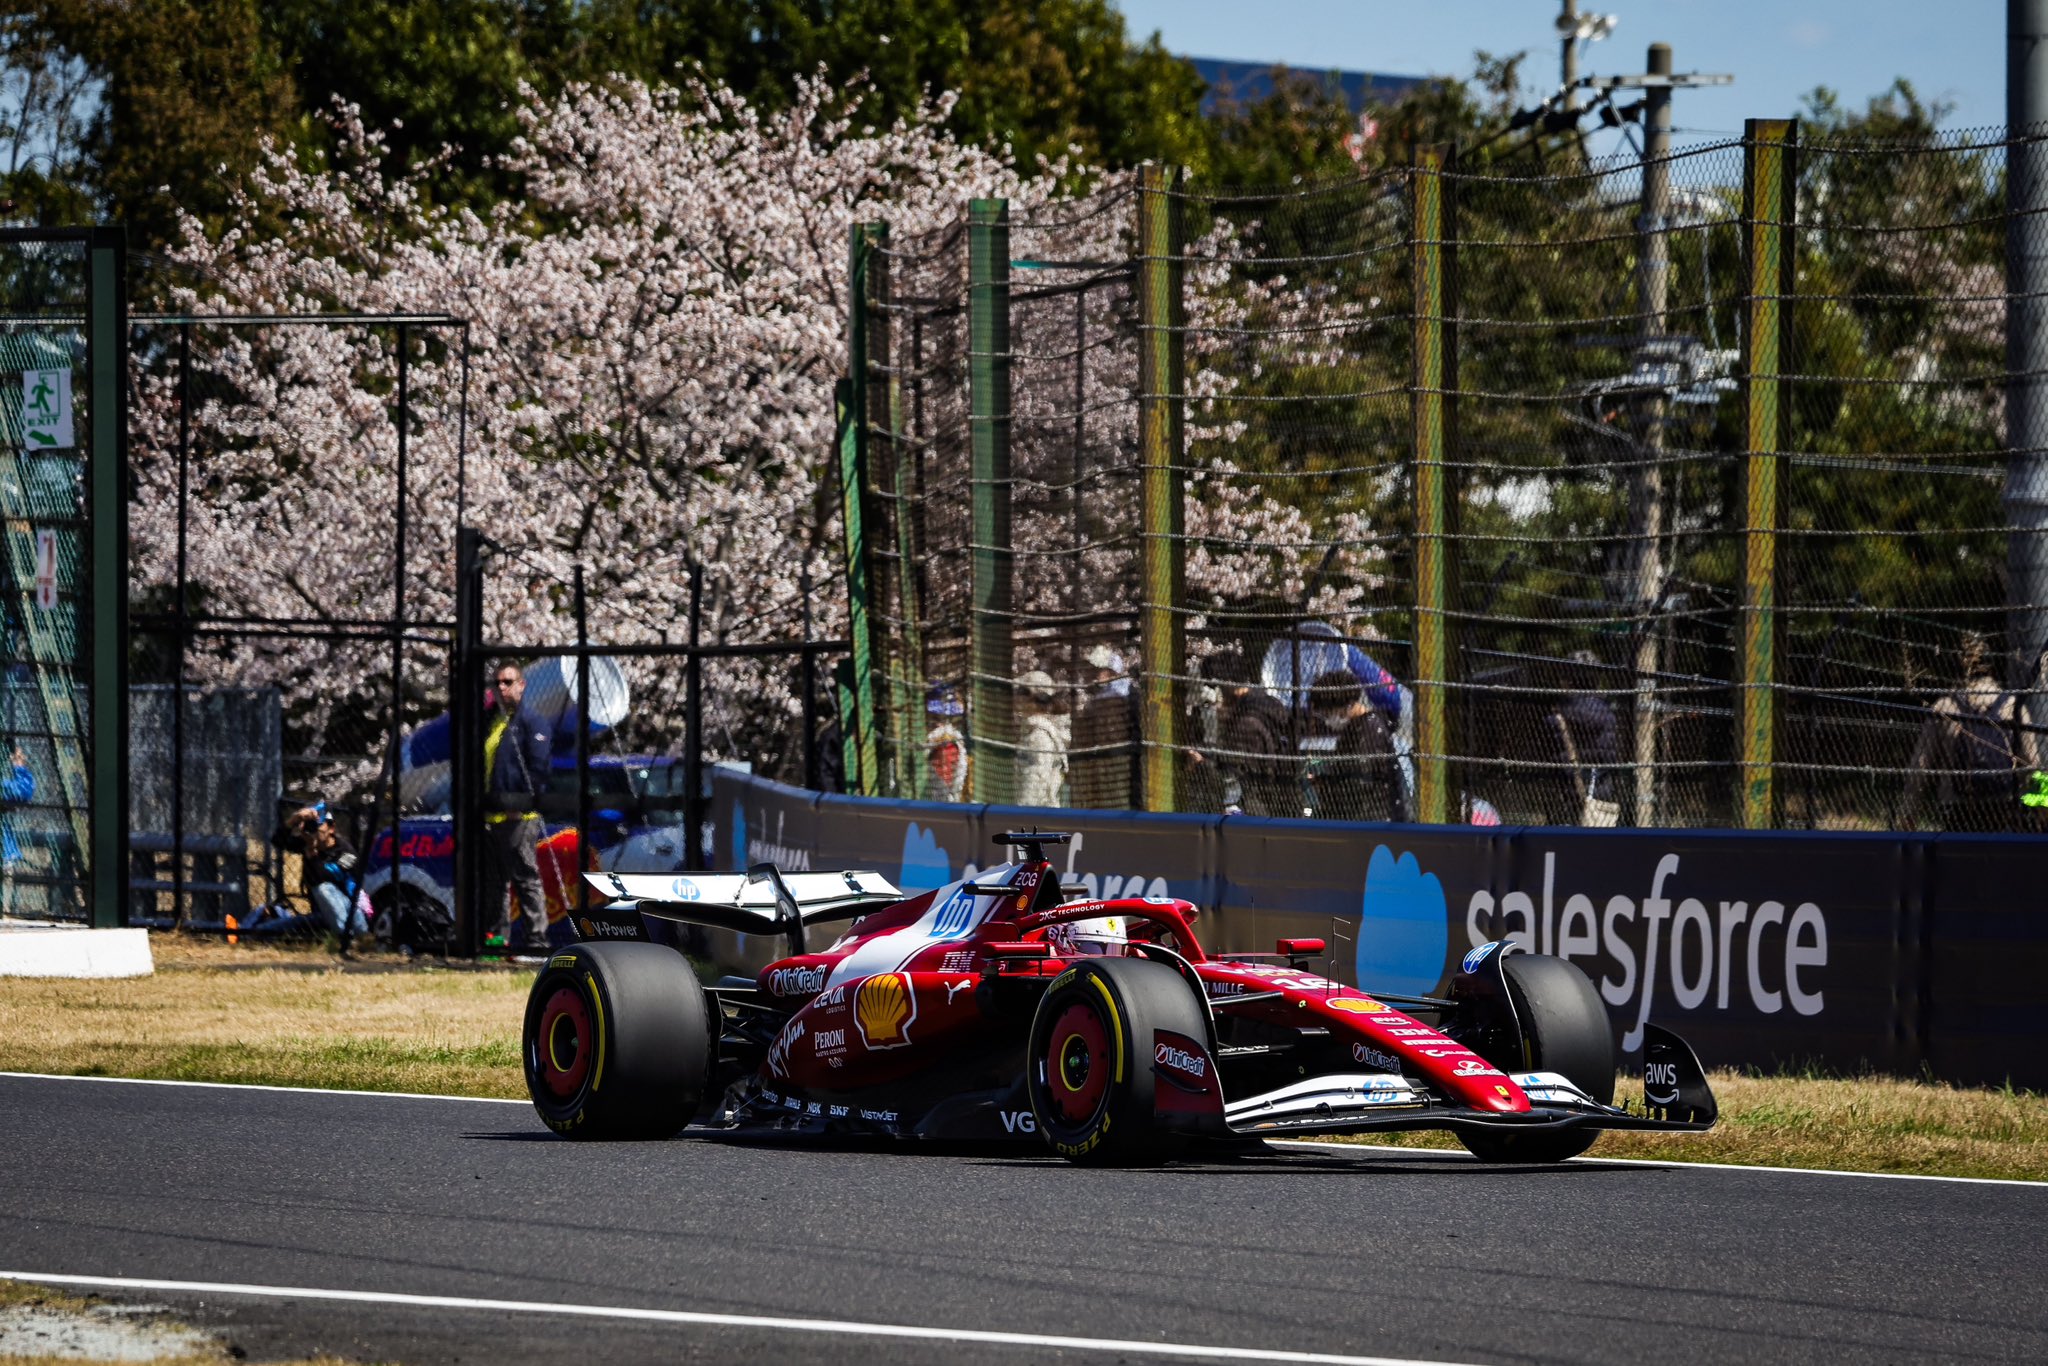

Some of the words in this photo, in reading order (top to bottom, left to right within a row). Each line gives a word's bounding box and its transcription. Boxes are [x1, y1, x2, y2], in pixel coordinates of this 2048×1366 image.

[28, 418, 60, 427] EXIT
[675, 880, 699, 900] hp
[1015, 872, 1038, 887] ZCG
[931, 884, 974, 938] hp
[1058, 904, 1105, 916] TECHNOLOGY
[592, 921, 637, 936] V-Power
[937, 951, 976, 974] IBM
[1466, 852, 1828, 1053] salesforce
[780, 964, 828, 995] UniCredit
[1211, 982, 1245, 994] MILLE
[814, 1029, 845, 1051] PERONI
[1387, 1028, 1437, 1036] IBM
[1166, 1047, 1205, 1077] UniCredit
[1362, 1046, 1401, 1073] UniCredit
[1645, 1063, 1677, 1086] aws
[806, 1101, 821, 1114] NGK
[829, 1104, 849, 1117] SKF
[1102, 1111, 1111, 1133] P
[1056, 1130, 1101, 1156] ZERO
